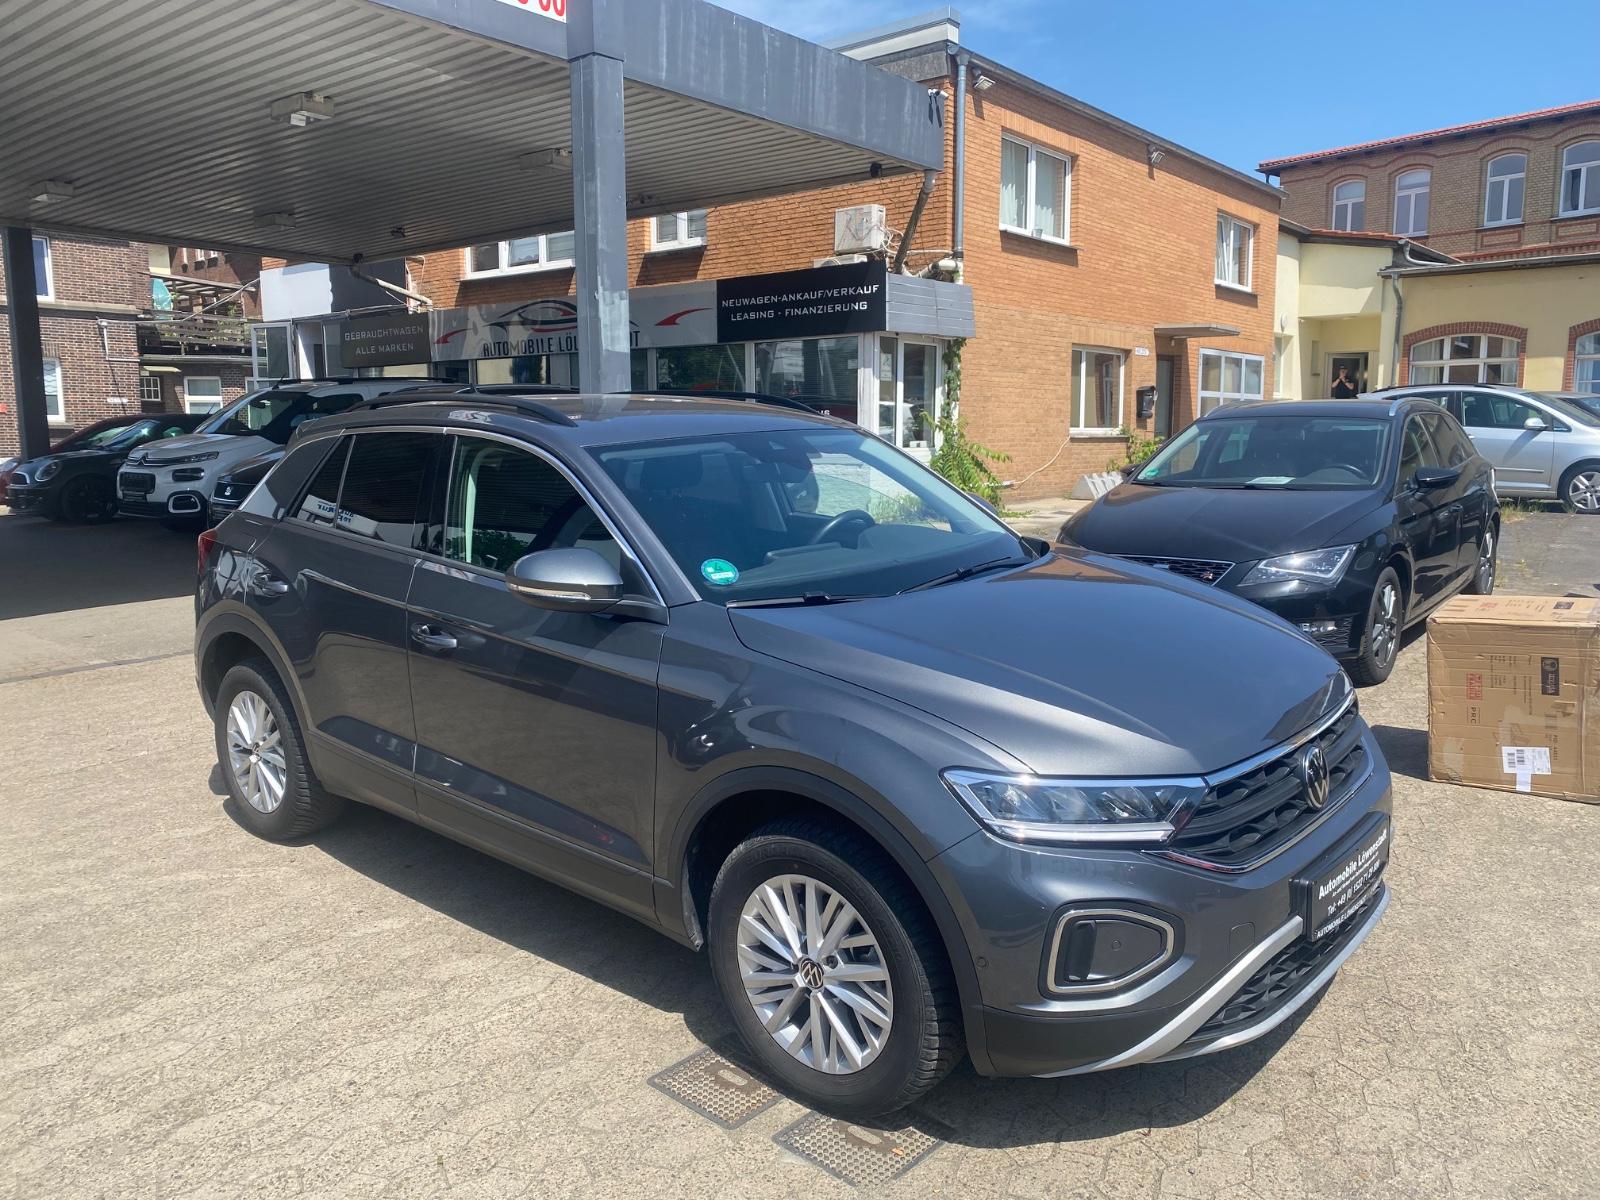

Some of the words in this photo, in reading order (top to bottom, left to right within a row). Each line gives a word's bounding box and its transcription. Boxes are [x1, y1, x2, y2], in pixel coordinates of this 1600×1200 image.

[721, 284, 880, 308] NEUWAGEN-ANKAUF/VERKAUF
[730, 310, 775, 321] LEASING
[784, 301, 868, 317] FINANZIERUNG
[344, 325, 424, 341] GEBRAUCHTWAGEN
[355, 345, 376, 356] ALLE
[378, 342, 414, 353] MARKEN
[483, 337, 554, 358] AUTOMOBILE
[1318, 860, 1357, 900] Automobile
